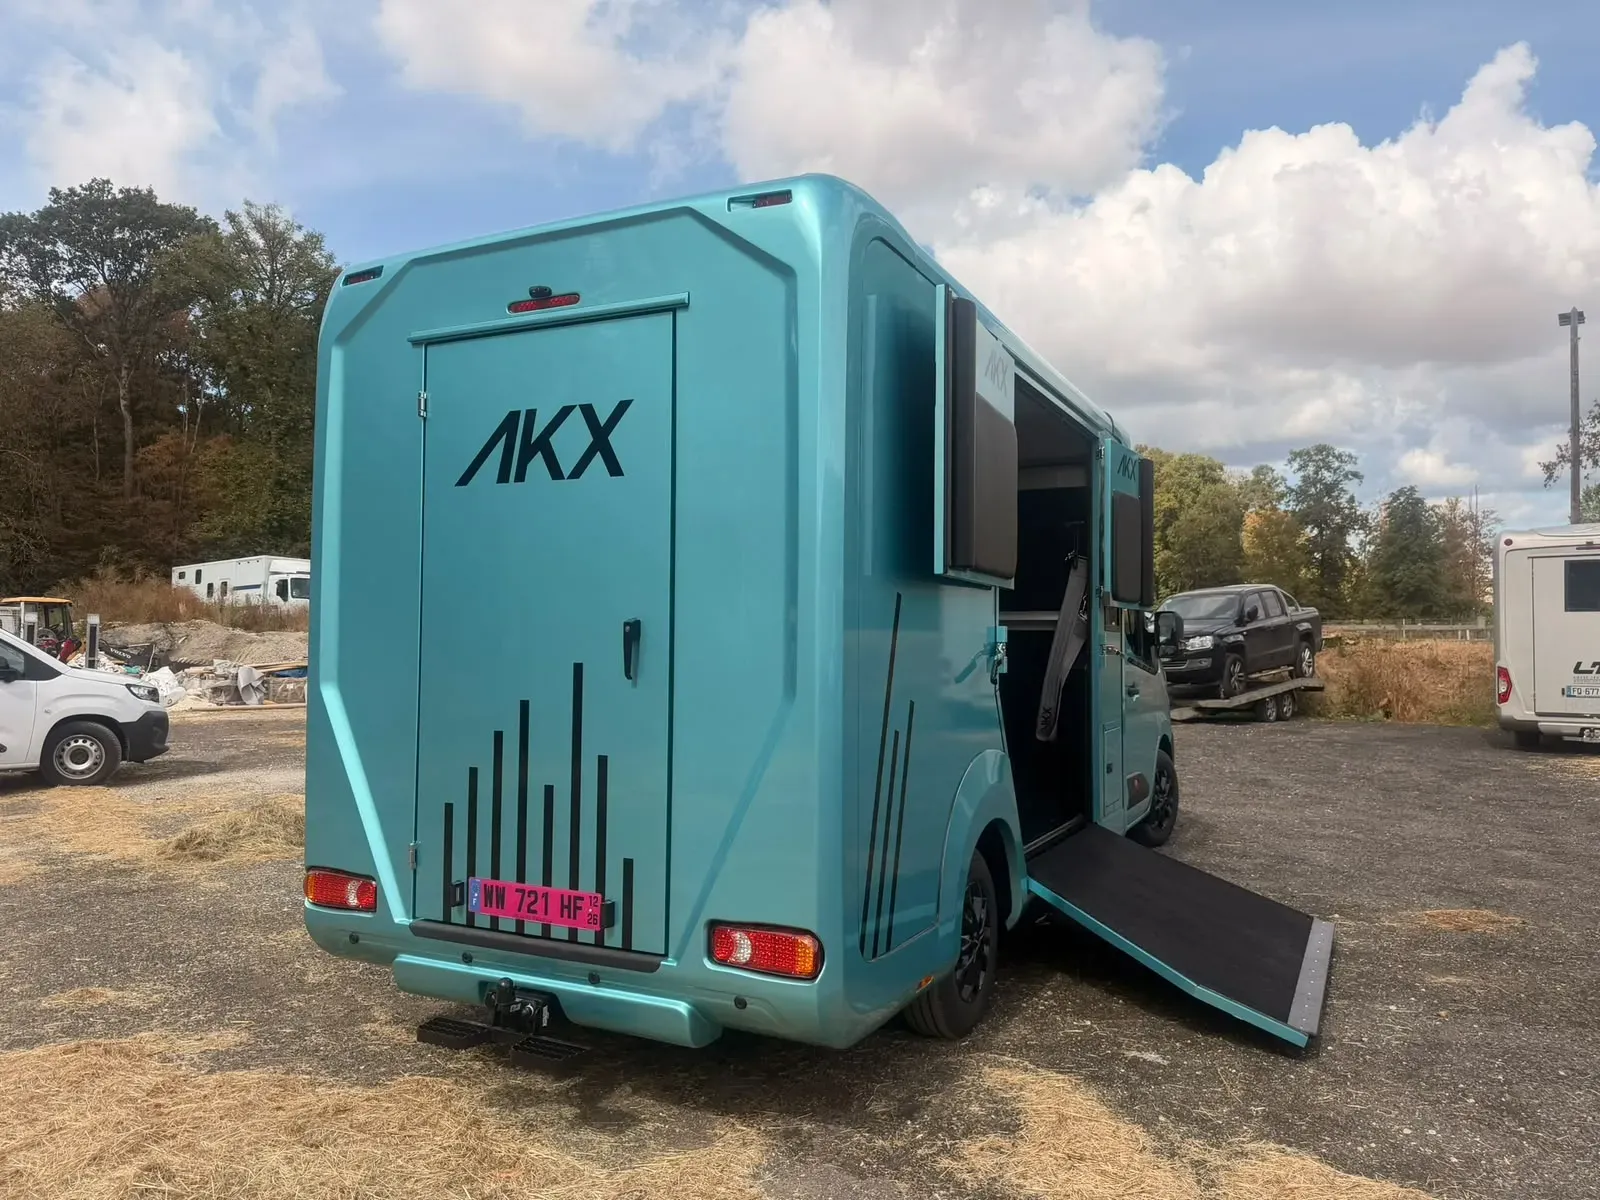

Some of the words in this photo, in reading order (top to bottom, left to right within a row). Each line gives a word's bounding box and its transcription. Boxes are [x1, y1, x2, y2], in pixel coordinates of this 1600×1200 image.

[454, 399, 635, 487] AKX
[1117, 454, 1137, 481] AKX
[110, 647, 131, 659] VOLVO
[483, 884, 506, 910] WW
[515, 888, 549, 916] 721
[560, 894, 585, 920] HF
[589, 896, 599, 907] 12
[587, 913, 599, 925] 26
